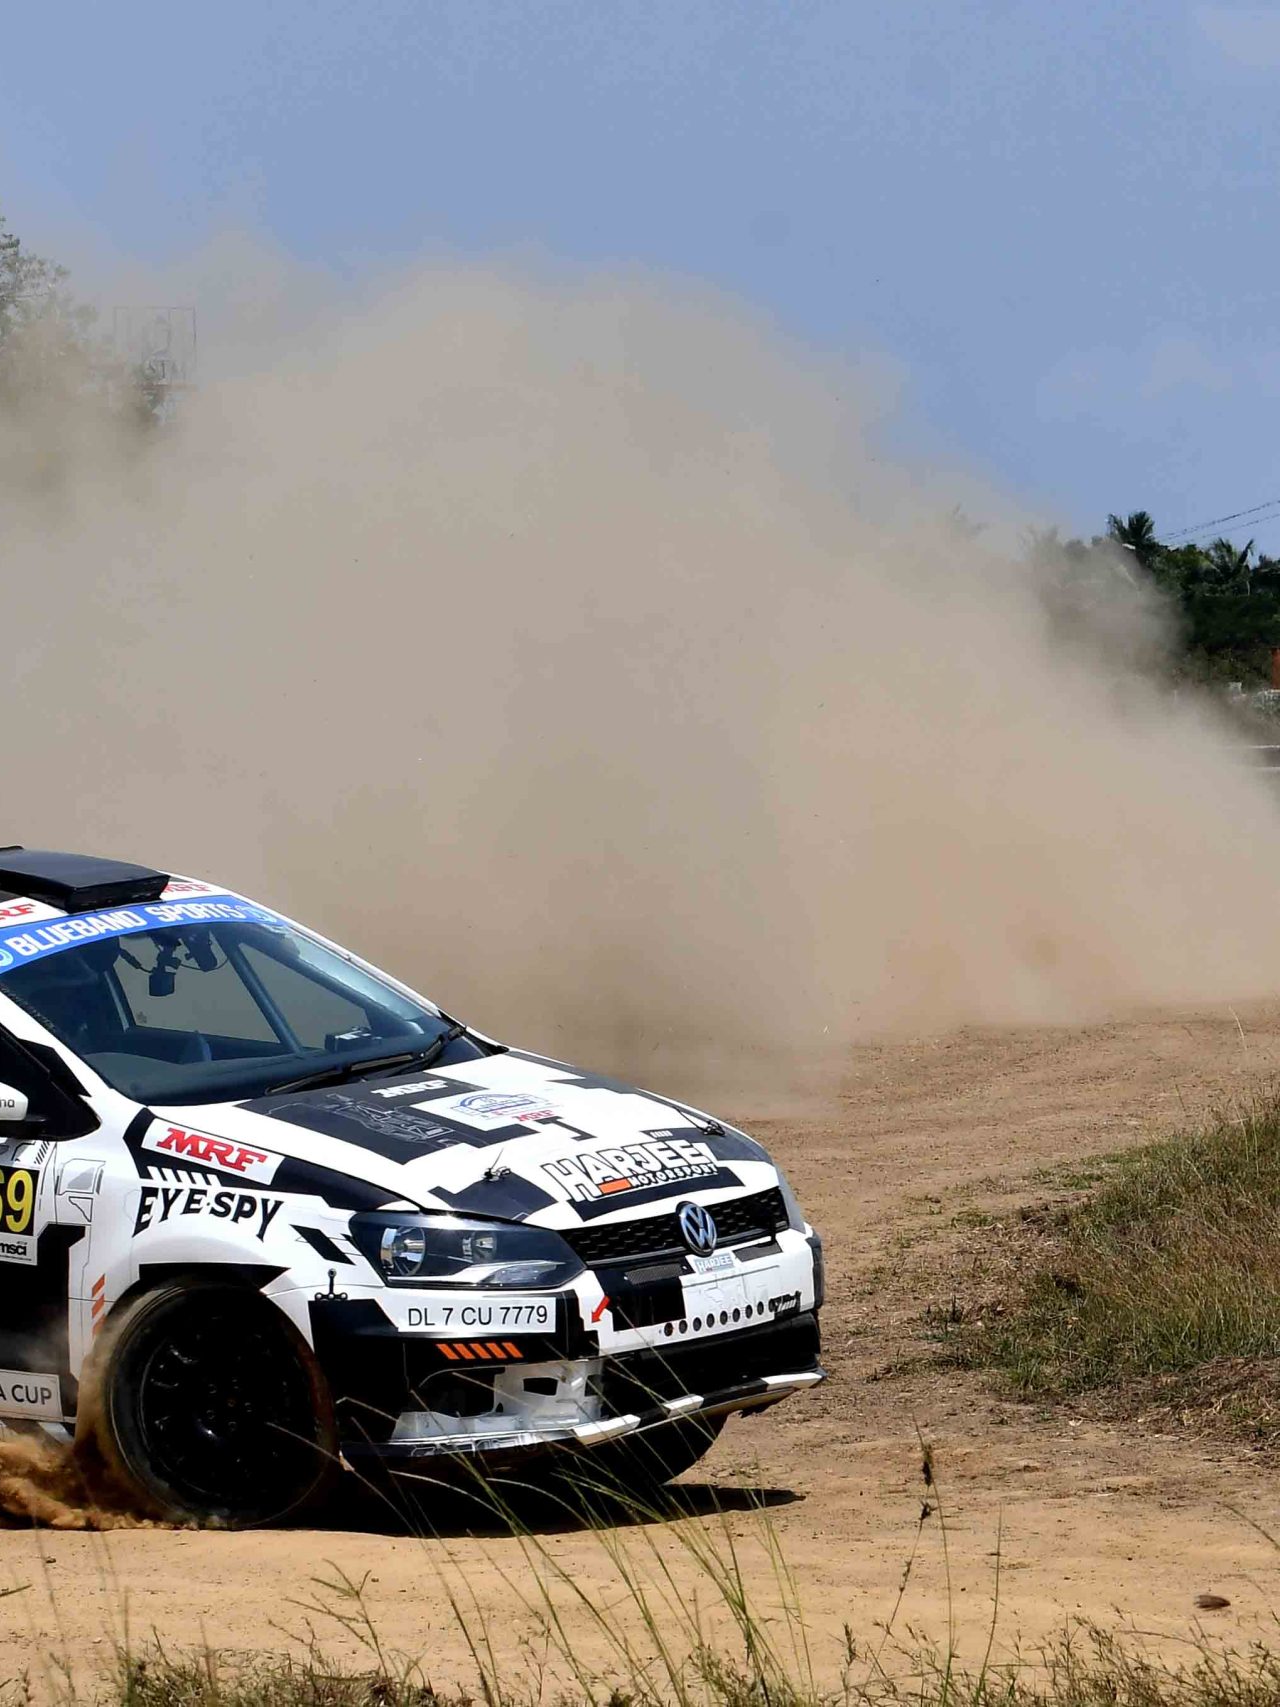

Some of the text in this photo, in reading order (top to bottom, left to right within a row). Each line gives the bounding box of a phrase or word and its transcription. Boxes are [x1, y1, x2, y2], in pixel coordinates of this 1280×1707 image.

[4, 903, 246, 957] BLUEBAND SPORTS
[370, 1079, 449, 1098] MRF
[156, 1127, 268, 1173] MRF
[540, 1138, 717, 1203] HARJEE
[628, 1162, 719, 1188] MOTORSPORT
[407, 1304, 548, 1326] DL 7 CU 7779
[10, 1384, 53, 1406] CUP
